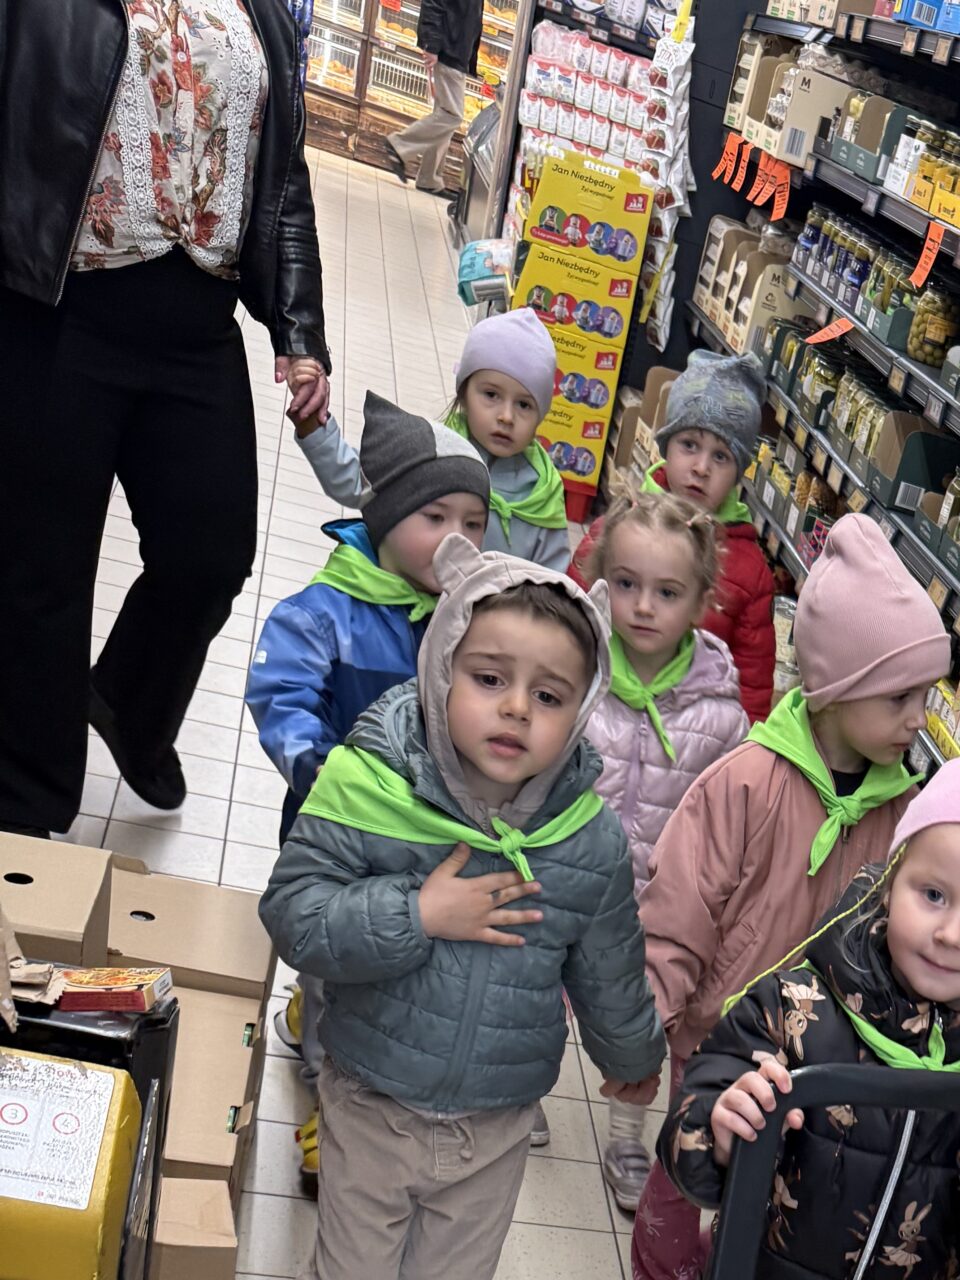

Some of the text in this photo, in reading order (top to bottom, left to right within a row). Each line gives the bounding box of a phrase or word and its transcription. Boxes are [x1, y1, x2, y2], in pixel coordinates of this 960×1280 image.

[551, 163, 616, 193] Jan Niezbędny
[537, 251, 556, 264] Jan
